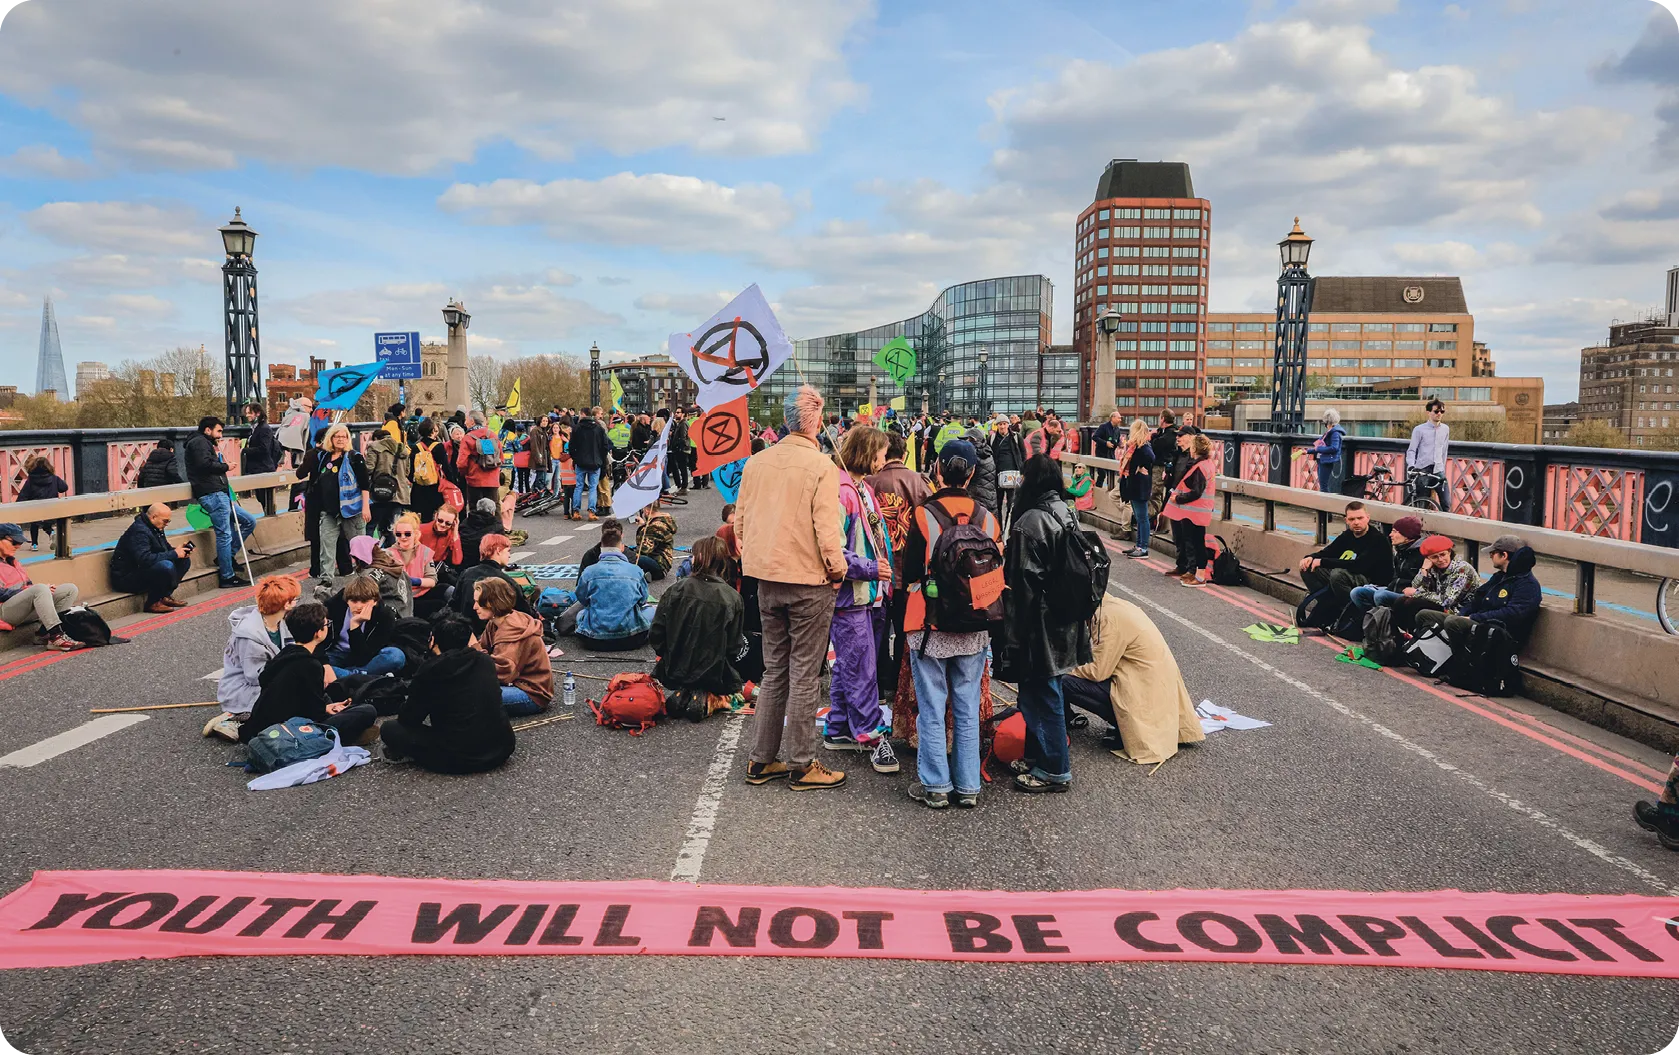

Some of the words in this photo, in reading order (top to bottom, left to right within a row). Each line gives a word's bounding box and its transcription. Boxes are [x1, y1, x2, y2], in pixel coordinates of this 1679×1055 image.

[981, 577, 998, 589] LEGAL
[30, 892, 377, 940] YOUTH
[412, 903, 640, 946] WILL
[690, 907, 893, 953] NOT
[944, 911, 1069, 953] BE
[1115, 913, 1663, 962] COMPLICIT
